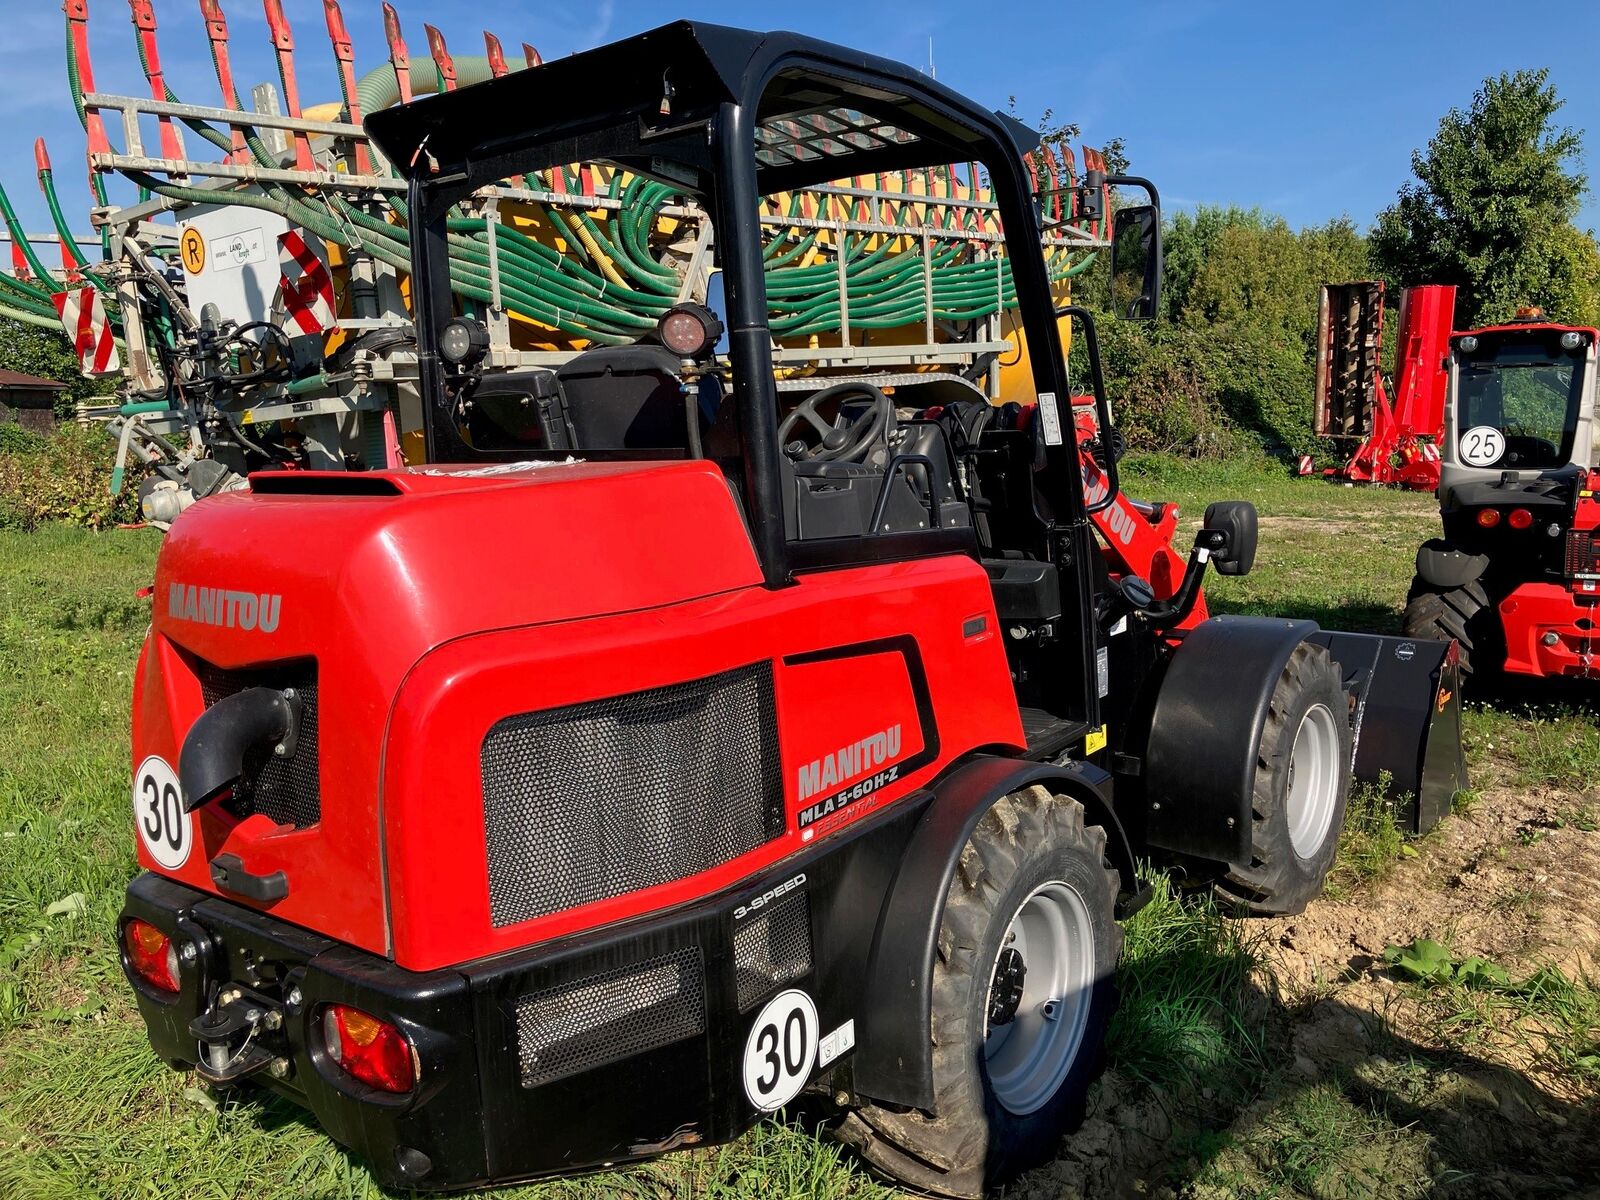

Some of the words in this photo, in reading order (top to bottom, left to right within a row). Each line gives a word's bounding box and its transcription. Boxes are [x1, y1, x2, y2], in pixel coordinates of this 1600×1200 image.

[187, 237, 200, 265] R
[229, 243, 242, 252] LAND
[1468, 434, 1496, 459] 25
[168, 582, 282, 633] MANITOU
[798, 723, 901, 802] MANITOU
[142, 774, 183, 852] 30
[800, 797, 835, 827] MLA
[816, 795, 877, 834] ESSENTIAL
[733, 872, 807, 920] 3-SPEED
[756, 1007, 807, 1095] 30
